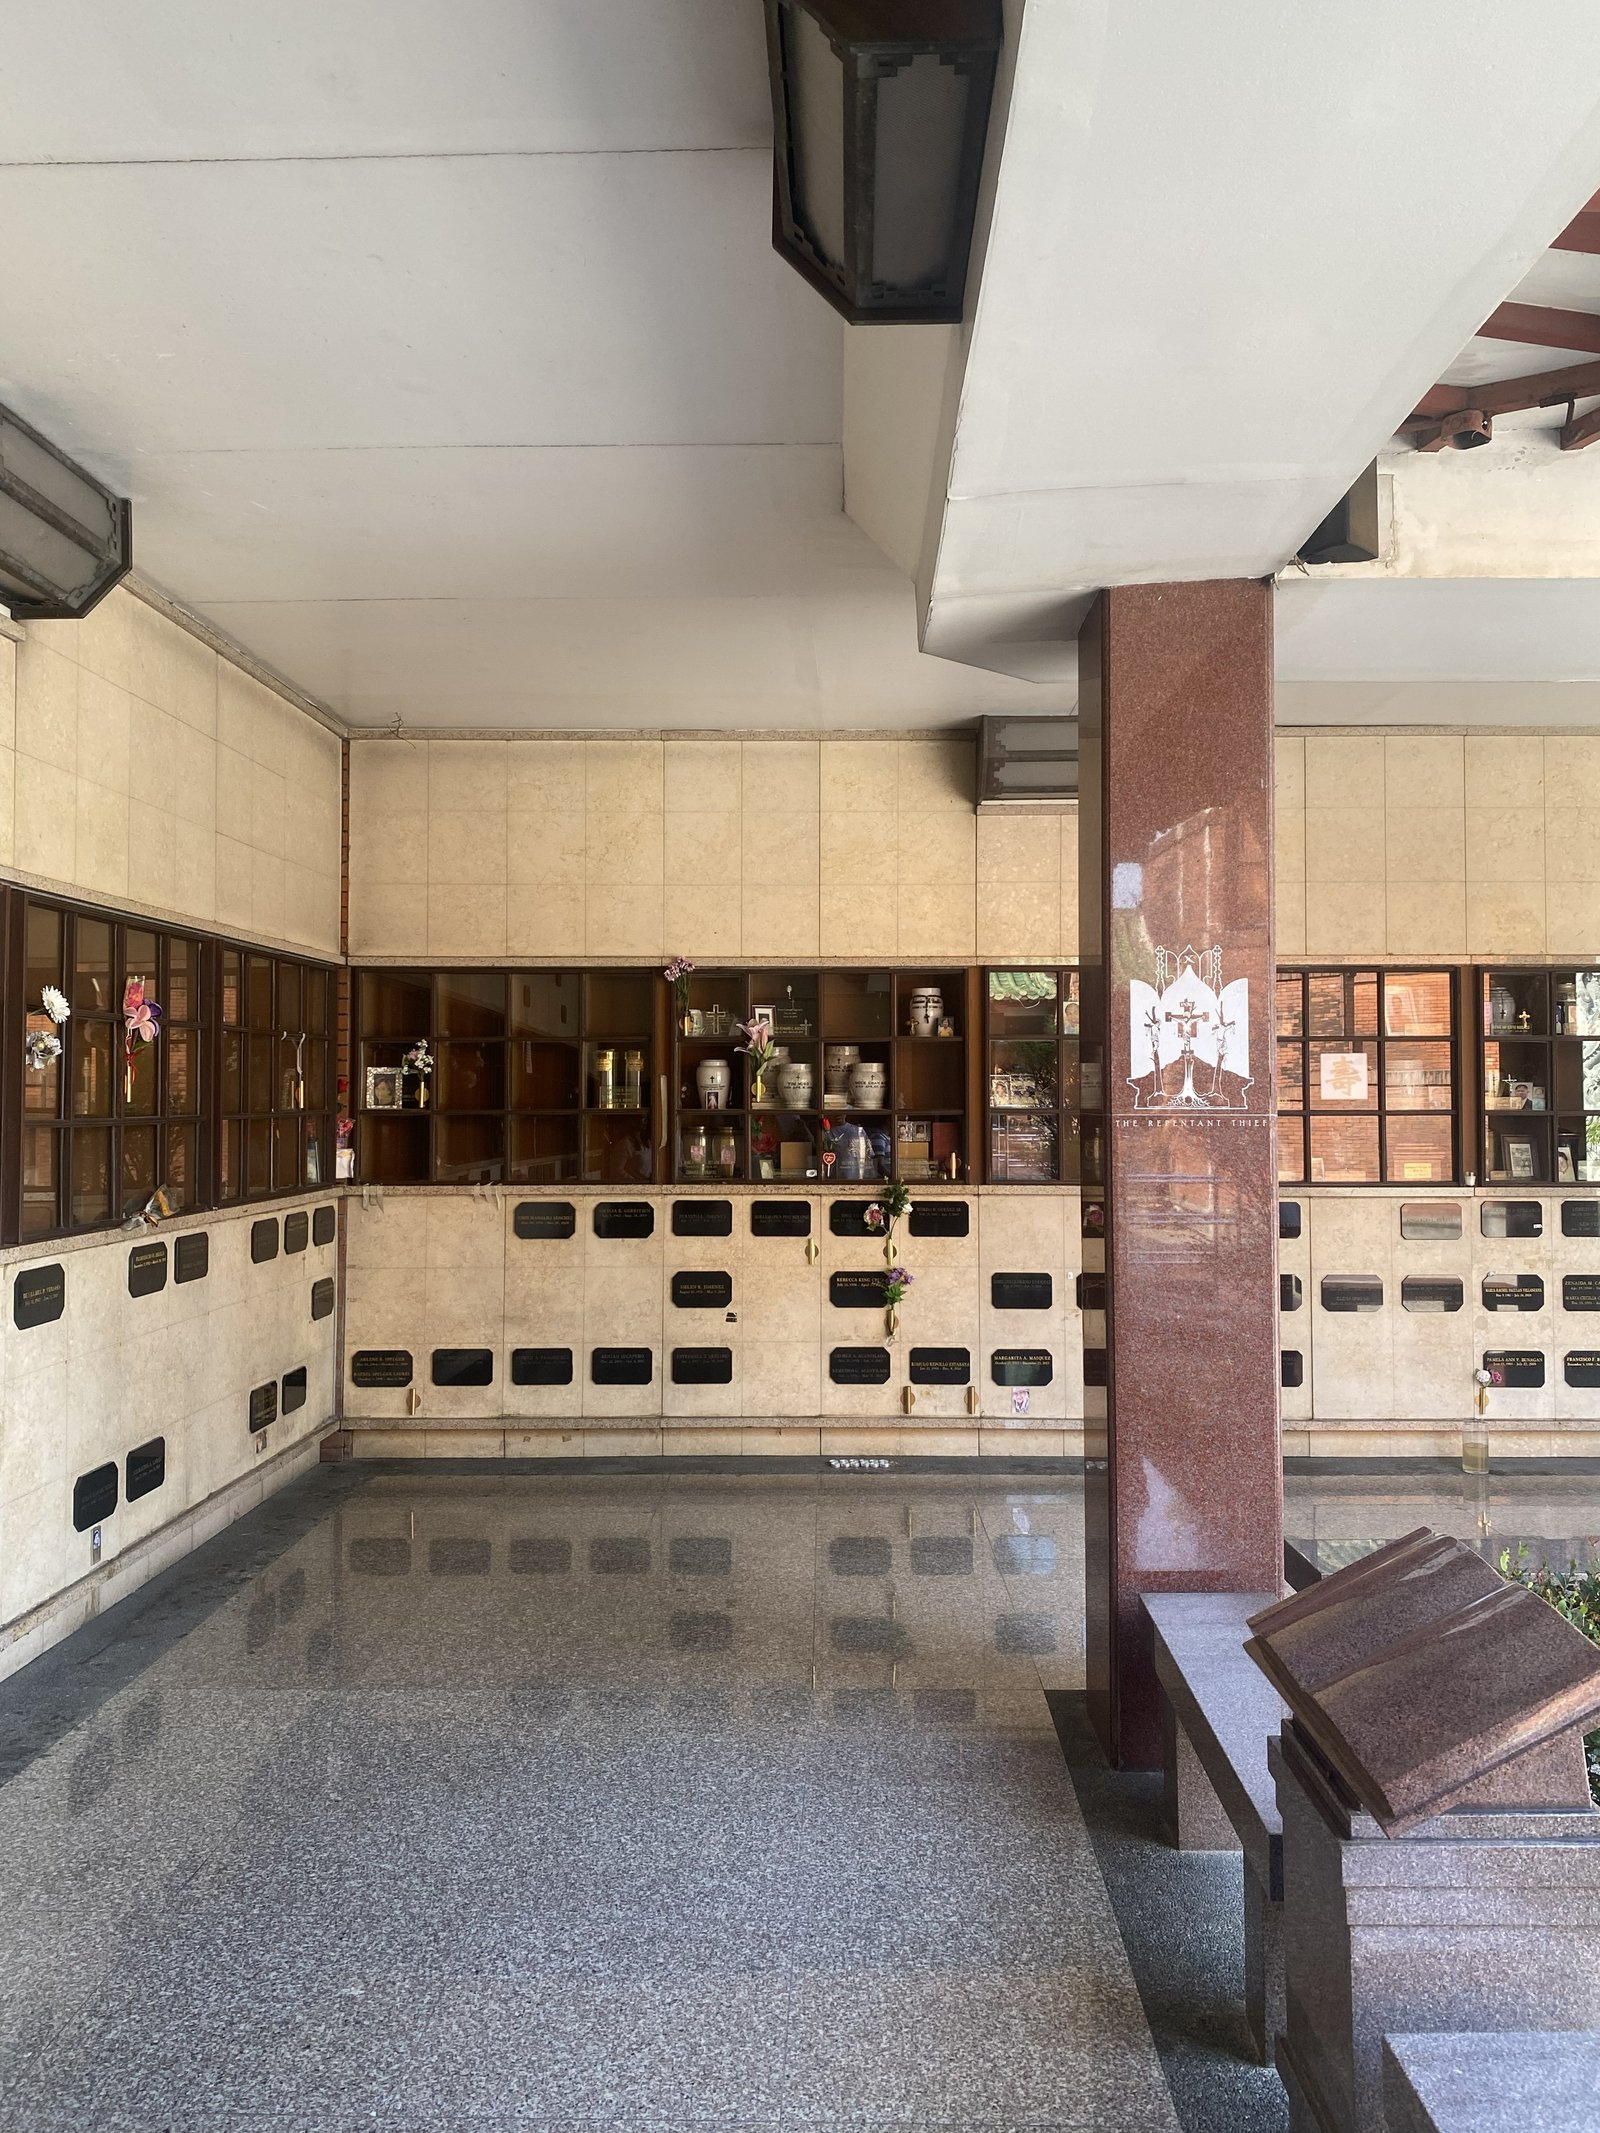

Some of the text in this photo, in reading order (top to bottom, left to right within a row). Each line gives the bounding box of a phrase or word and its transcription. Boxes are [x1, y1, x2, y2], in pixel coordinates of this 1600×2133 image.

[1115, 1119, 1269, 1127] THE REPENTANT THIEF
